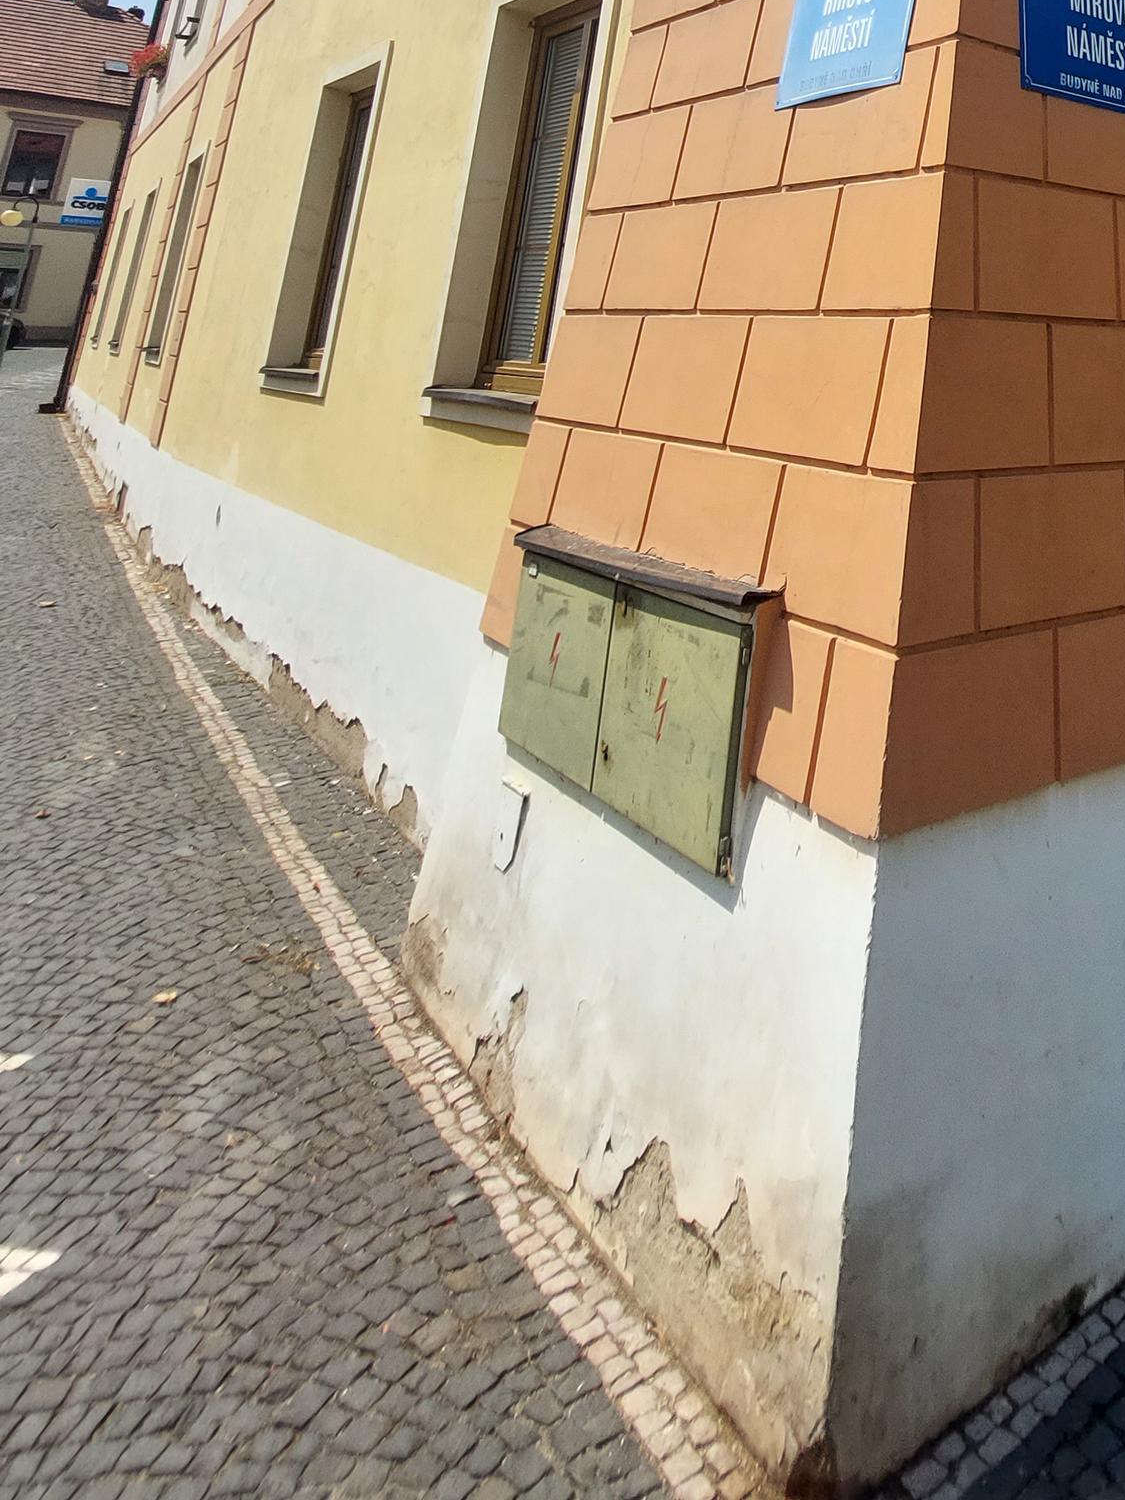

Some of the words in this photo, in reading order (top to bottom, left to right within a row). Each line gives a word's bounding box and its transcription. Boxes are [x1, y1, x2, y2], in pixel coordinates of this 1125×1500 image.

[809, 9, 875, 61] NÁMĚSTÍ
[1060, 72, 1101, 95] BUDYNĚ
[1102, 83, 1122, 100] NAD
